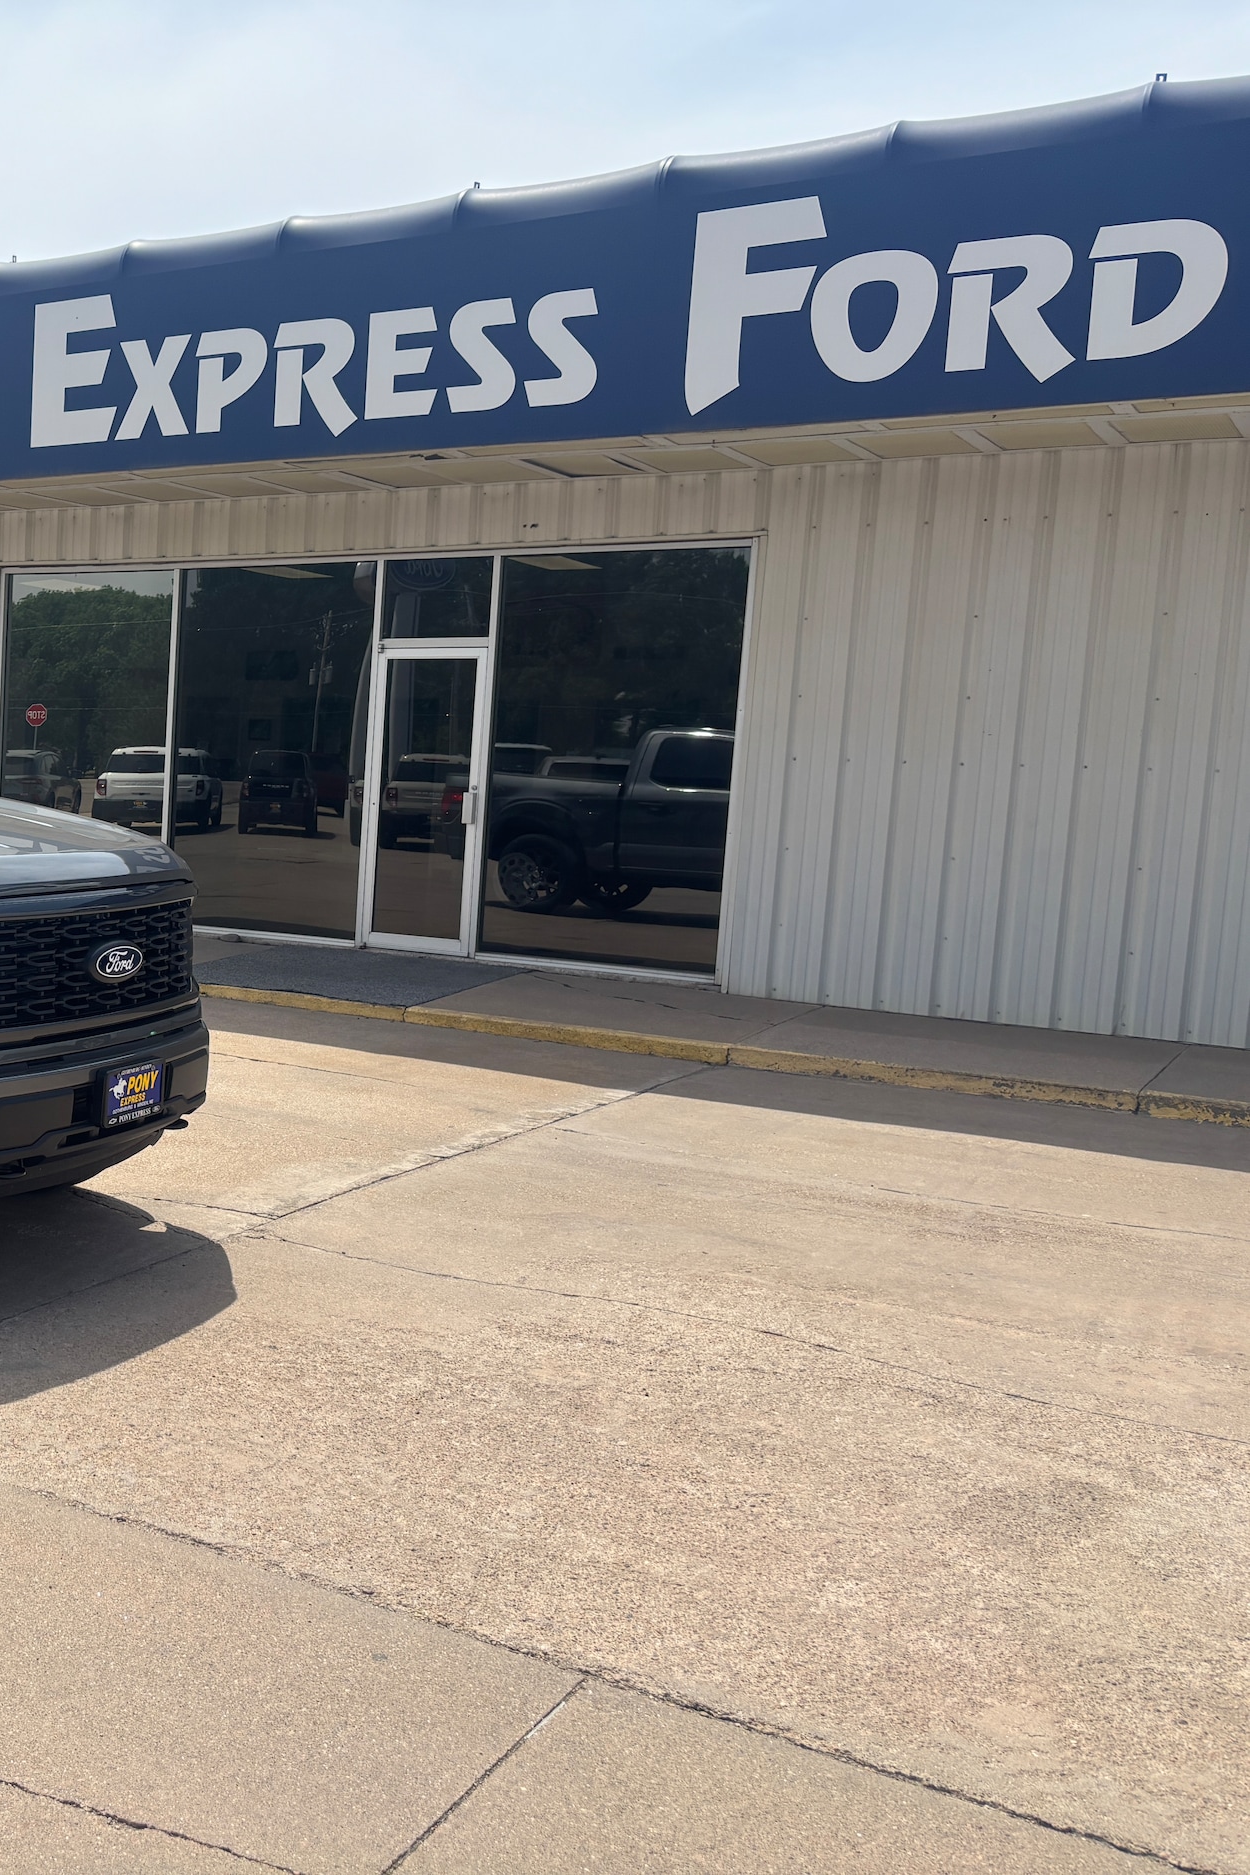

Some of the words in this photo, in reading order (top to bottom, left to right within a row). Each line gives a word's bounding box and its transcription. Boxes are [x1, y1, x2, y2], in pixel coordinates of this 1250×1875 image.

[30, 288, 599, 448] EXPRESS
[684, 195, 1229, 416] FORD
[106, 950, 135, 973] Ford
[127, 1070, 159, 1095] PONY
[120, 1092, 146, 1106] EXPRESS
